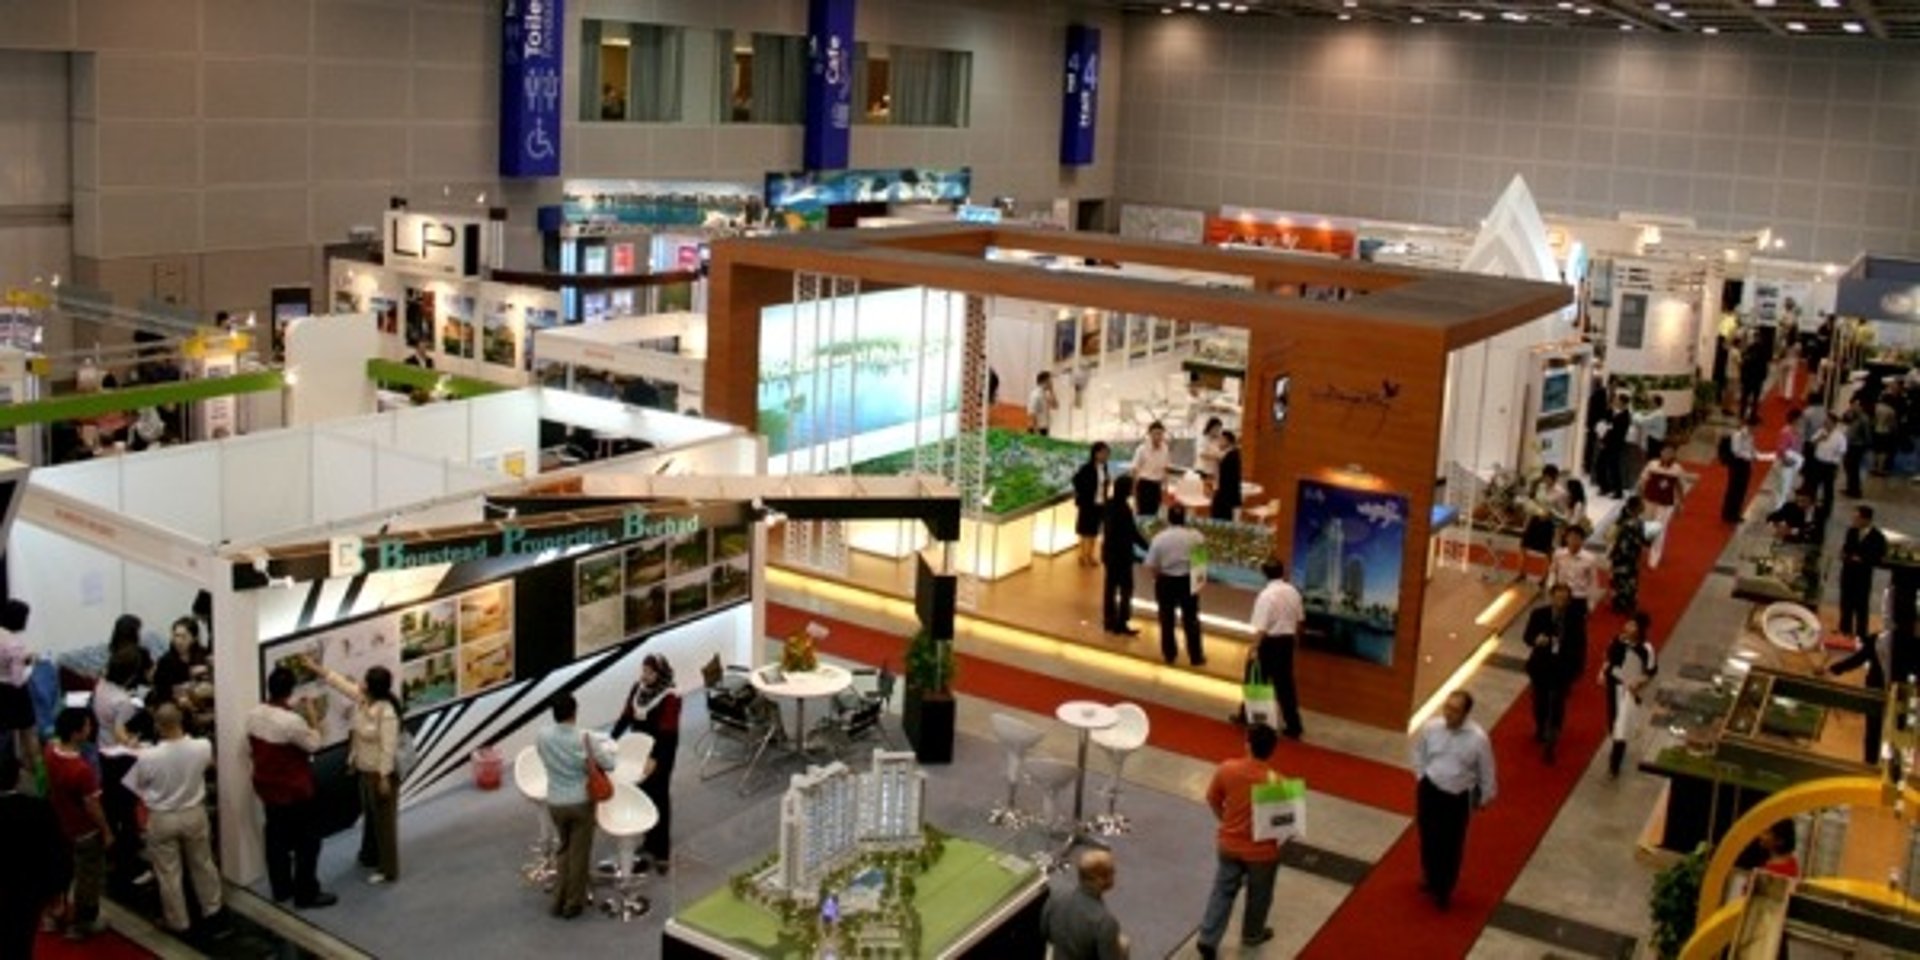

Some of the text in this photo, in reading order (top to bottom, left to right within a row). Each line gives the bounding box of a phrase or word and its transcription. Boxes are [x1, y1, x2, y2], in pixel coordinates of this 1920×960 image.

[826, 35, 840, 84] Cafe
[1083, 52, 1097, 91] 4
[379, 537, 489, 571] Boustead
[503, 521, 610, 555] Properties
[623, 503, 699, 539] Berhad
